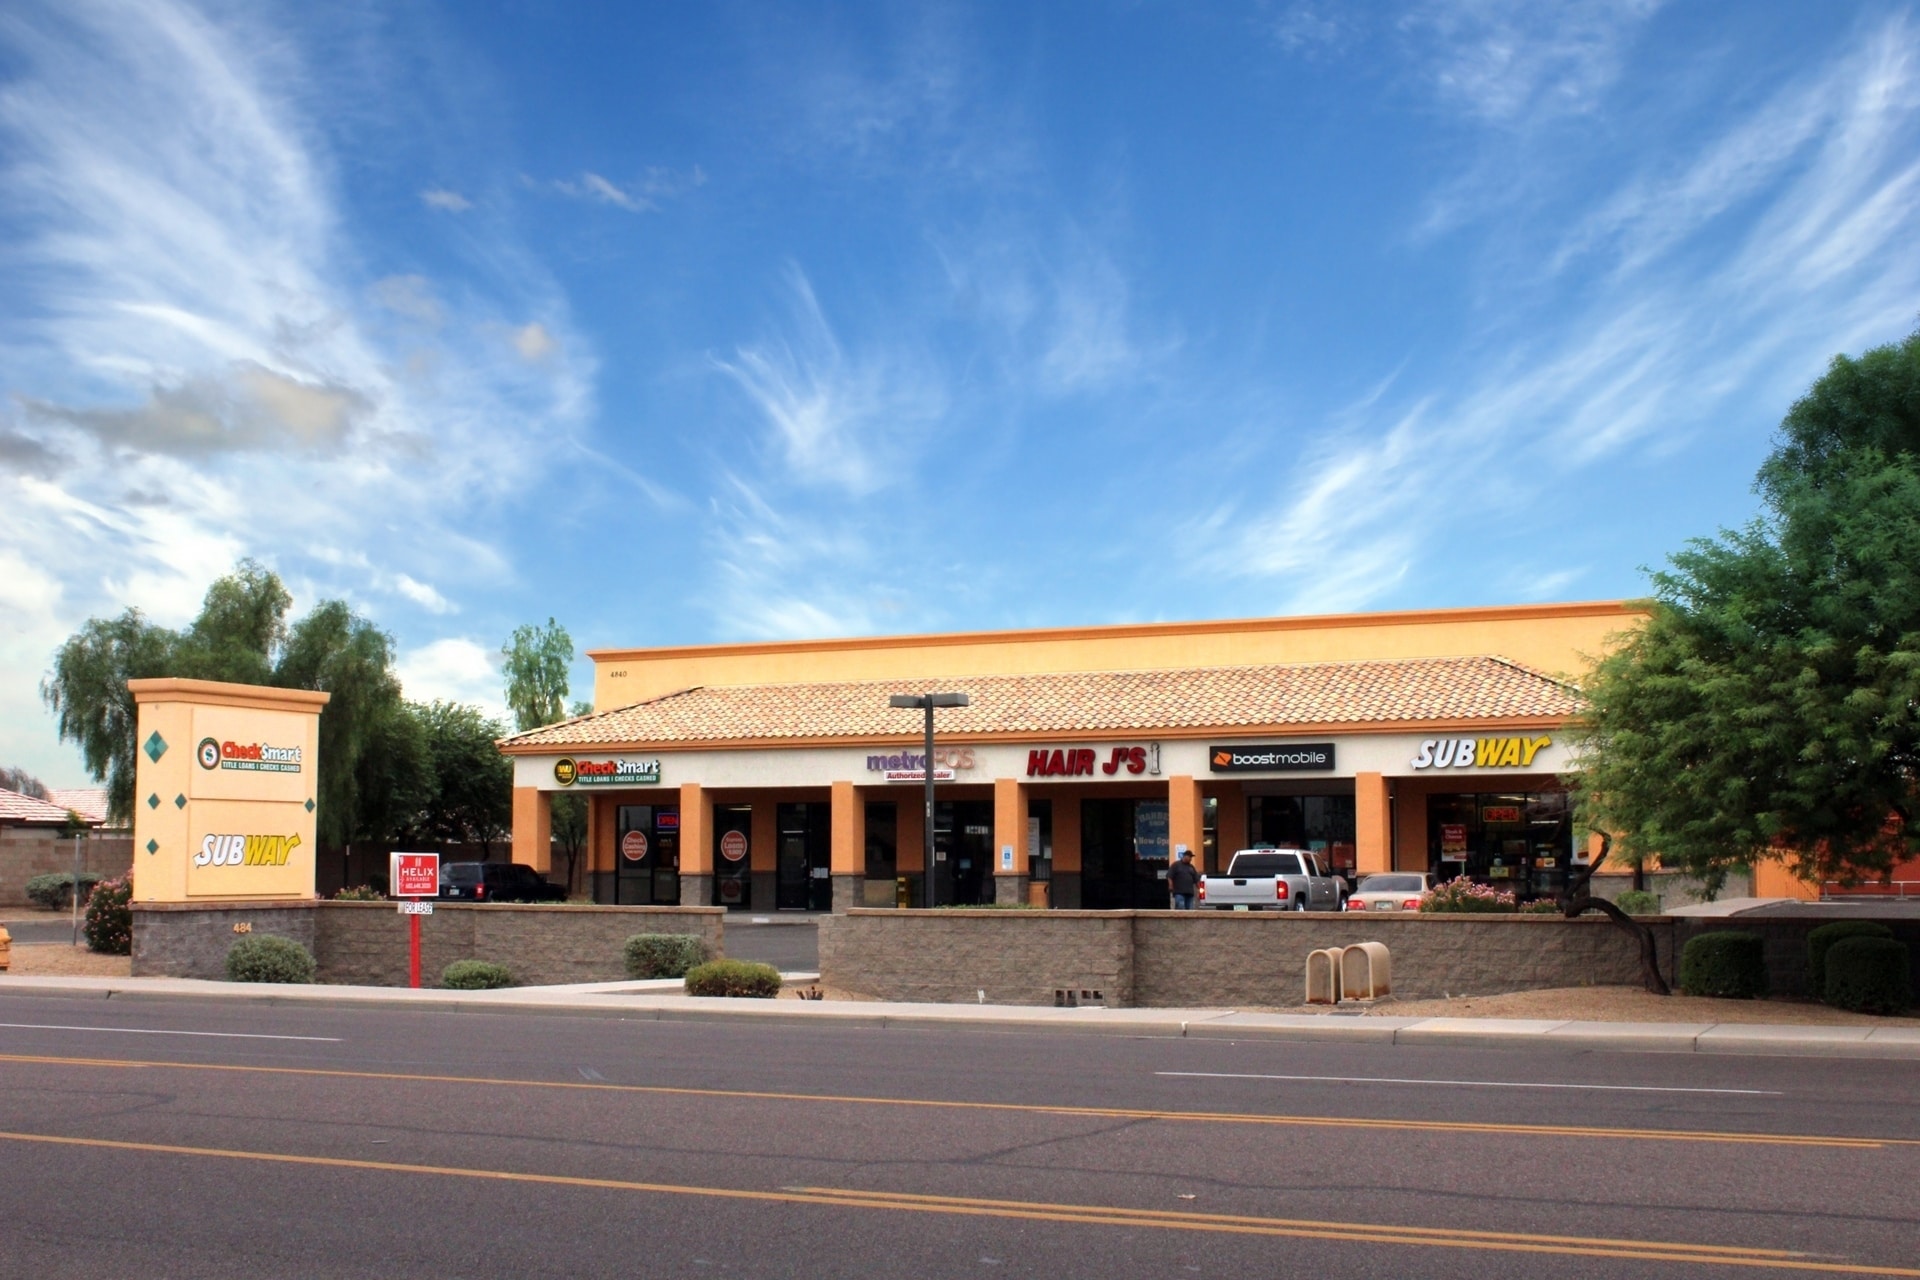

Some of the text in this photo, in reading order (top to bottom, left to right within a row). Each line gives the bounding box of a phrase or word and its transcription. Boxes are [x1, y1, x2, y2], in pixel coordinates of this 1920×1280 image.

[1410, 735, 1552, 769] SUBWAY
[222, 761, 300, 772] TITLE LOANS CHECKS CASHED
[1026, 746, 1147, 776] HAIR J'S
[887, 771, 926, 779] Authorized
[1485, 808, 1518, 820] OPEN
[193, 832, 301, 869] SUBWAY
[401, 867, 434, 877] HELIX
[405, 902, 433, 914] FOR LEASE
